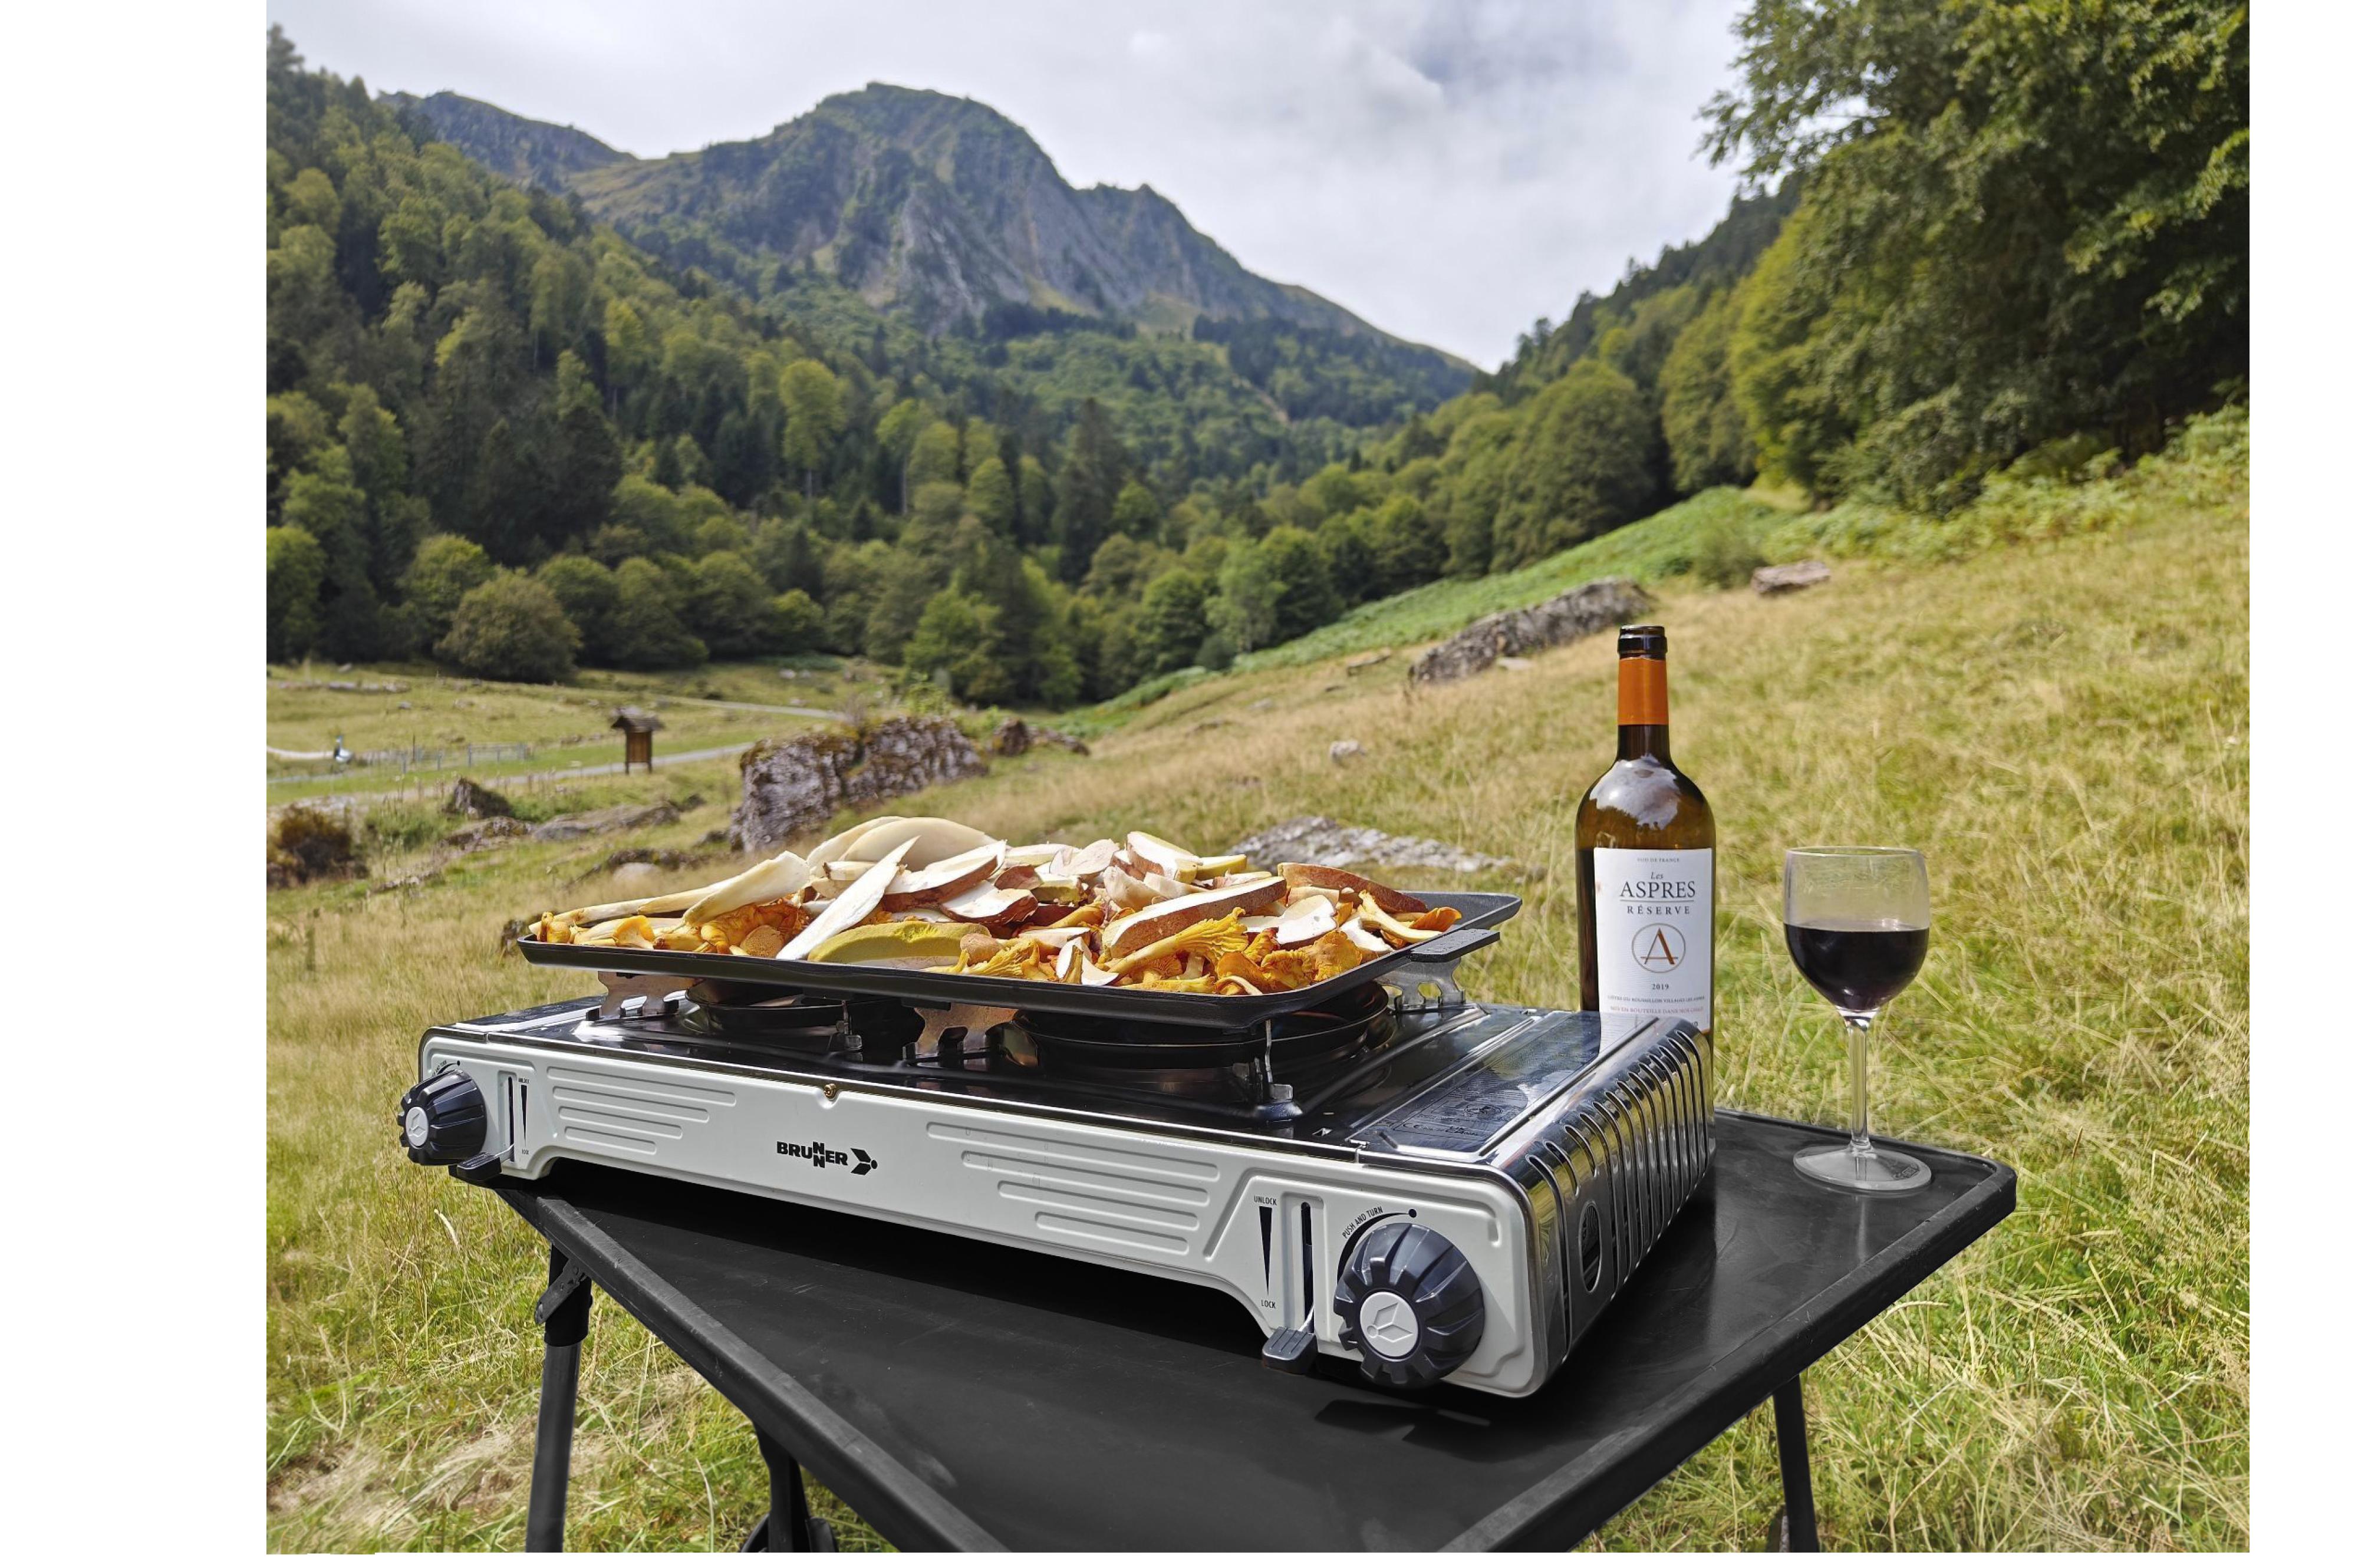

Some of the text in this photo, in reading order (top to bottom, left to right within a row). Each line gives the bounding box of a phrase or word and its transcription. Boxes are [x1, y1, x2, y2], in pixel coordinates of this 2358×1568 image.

[1619, 881, 1695, 898] ASPRES
[1627, 904, 1690, 915] RÉSERVE
[1641, 927, 1678, 965] A
[776, 1141, 848, 1168] BRUNNER
[1253, 1195, 1277, 1205] UNLOCK
[1342, 1206, 1383, 1238] PUSH AND TURN
[1261, 1299, 1276, 1309] LOCK
